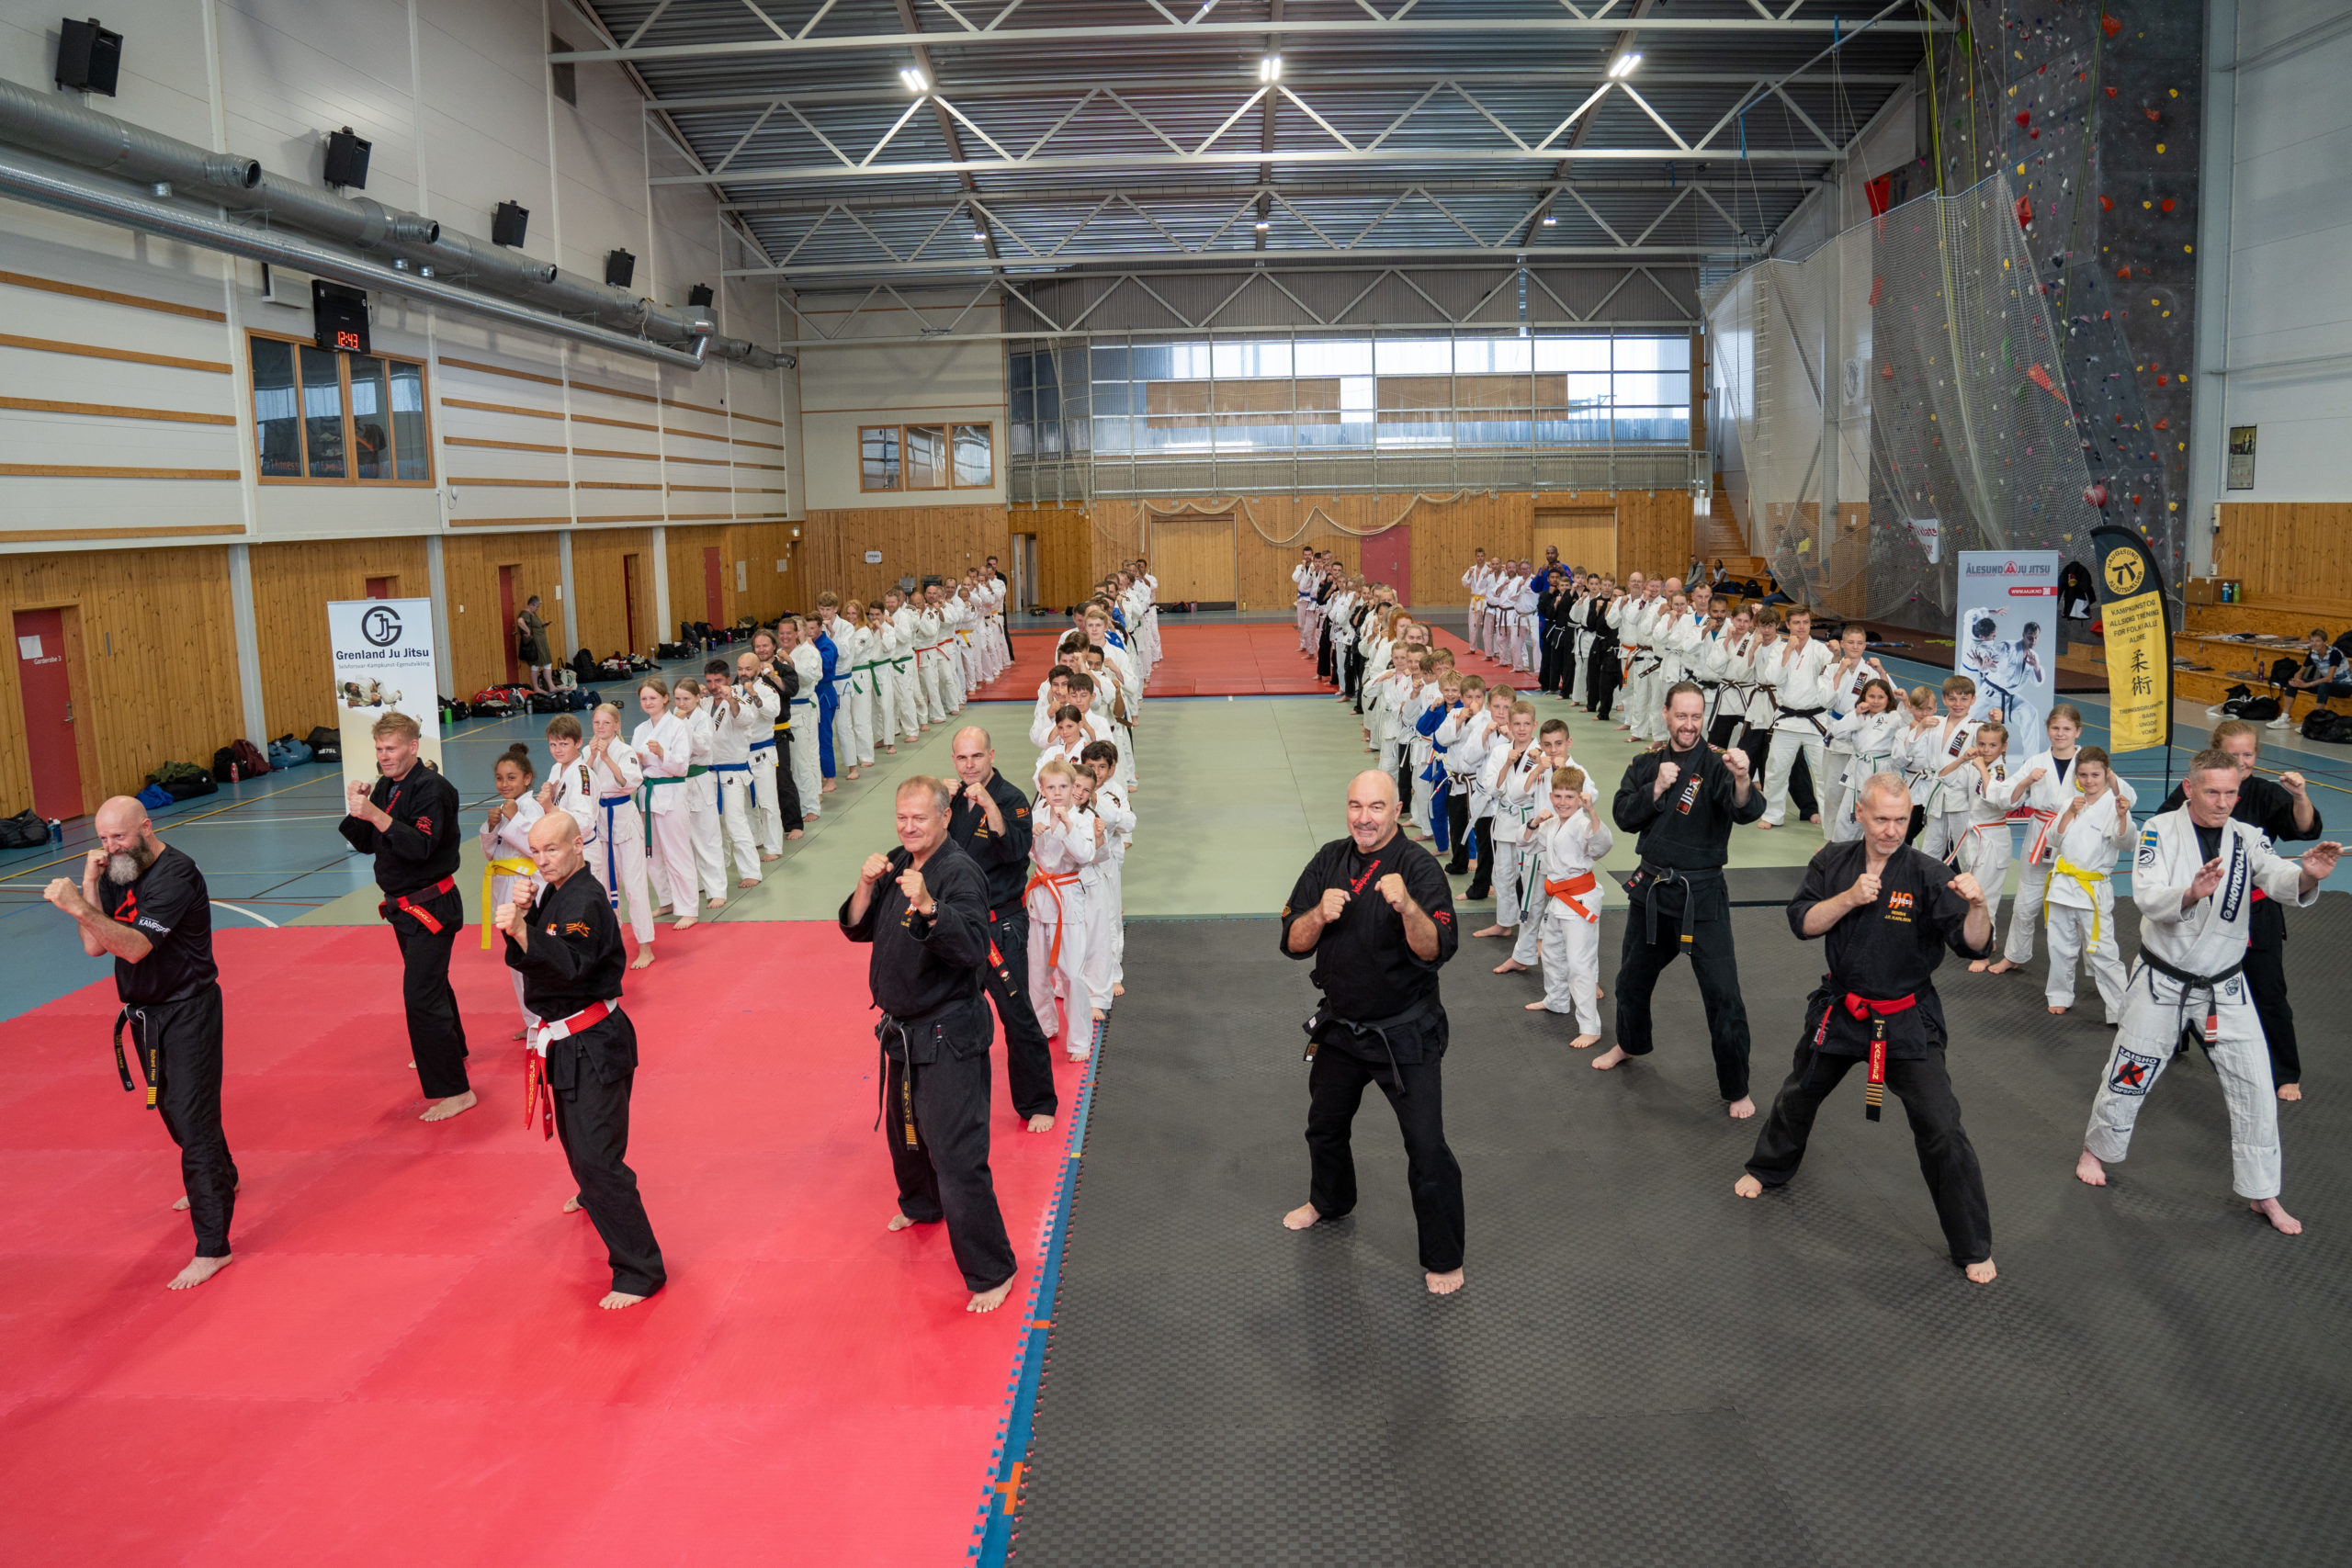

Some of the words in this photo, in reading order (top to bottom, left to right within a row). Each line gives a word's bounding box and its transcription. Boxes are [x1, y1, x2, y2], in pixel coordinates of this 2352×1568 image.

[337, 331, 359, 349] 12:43
[2107, 548, 2139, 569] HAUGESUND
[1966, 562, 2003, 574] ÅLESUND
[2018, 565, 2027, 574] JU
[2029, 565, 2051, 573] JITSU
[2111, 602, 2145, 616] KAMPKUNST
[2146, 599, 2156, 607] OG
[2109, 615, 2136, 627] ALLSIDIG
[2137, 609, 2160, 621] TRENING
[2144, 620, 2158, 628] ALLE
[34, 656, 58, 665] Garderobe
[335, 649, 385, 660] Grenland
[389, 649, 401, 659] Ju
[403, 648, 429, 658] Jitsu
[2226, 848, 2245, 911] SHOYOROLL
[1871, 1043, 1882, 1080] KARLSEN
